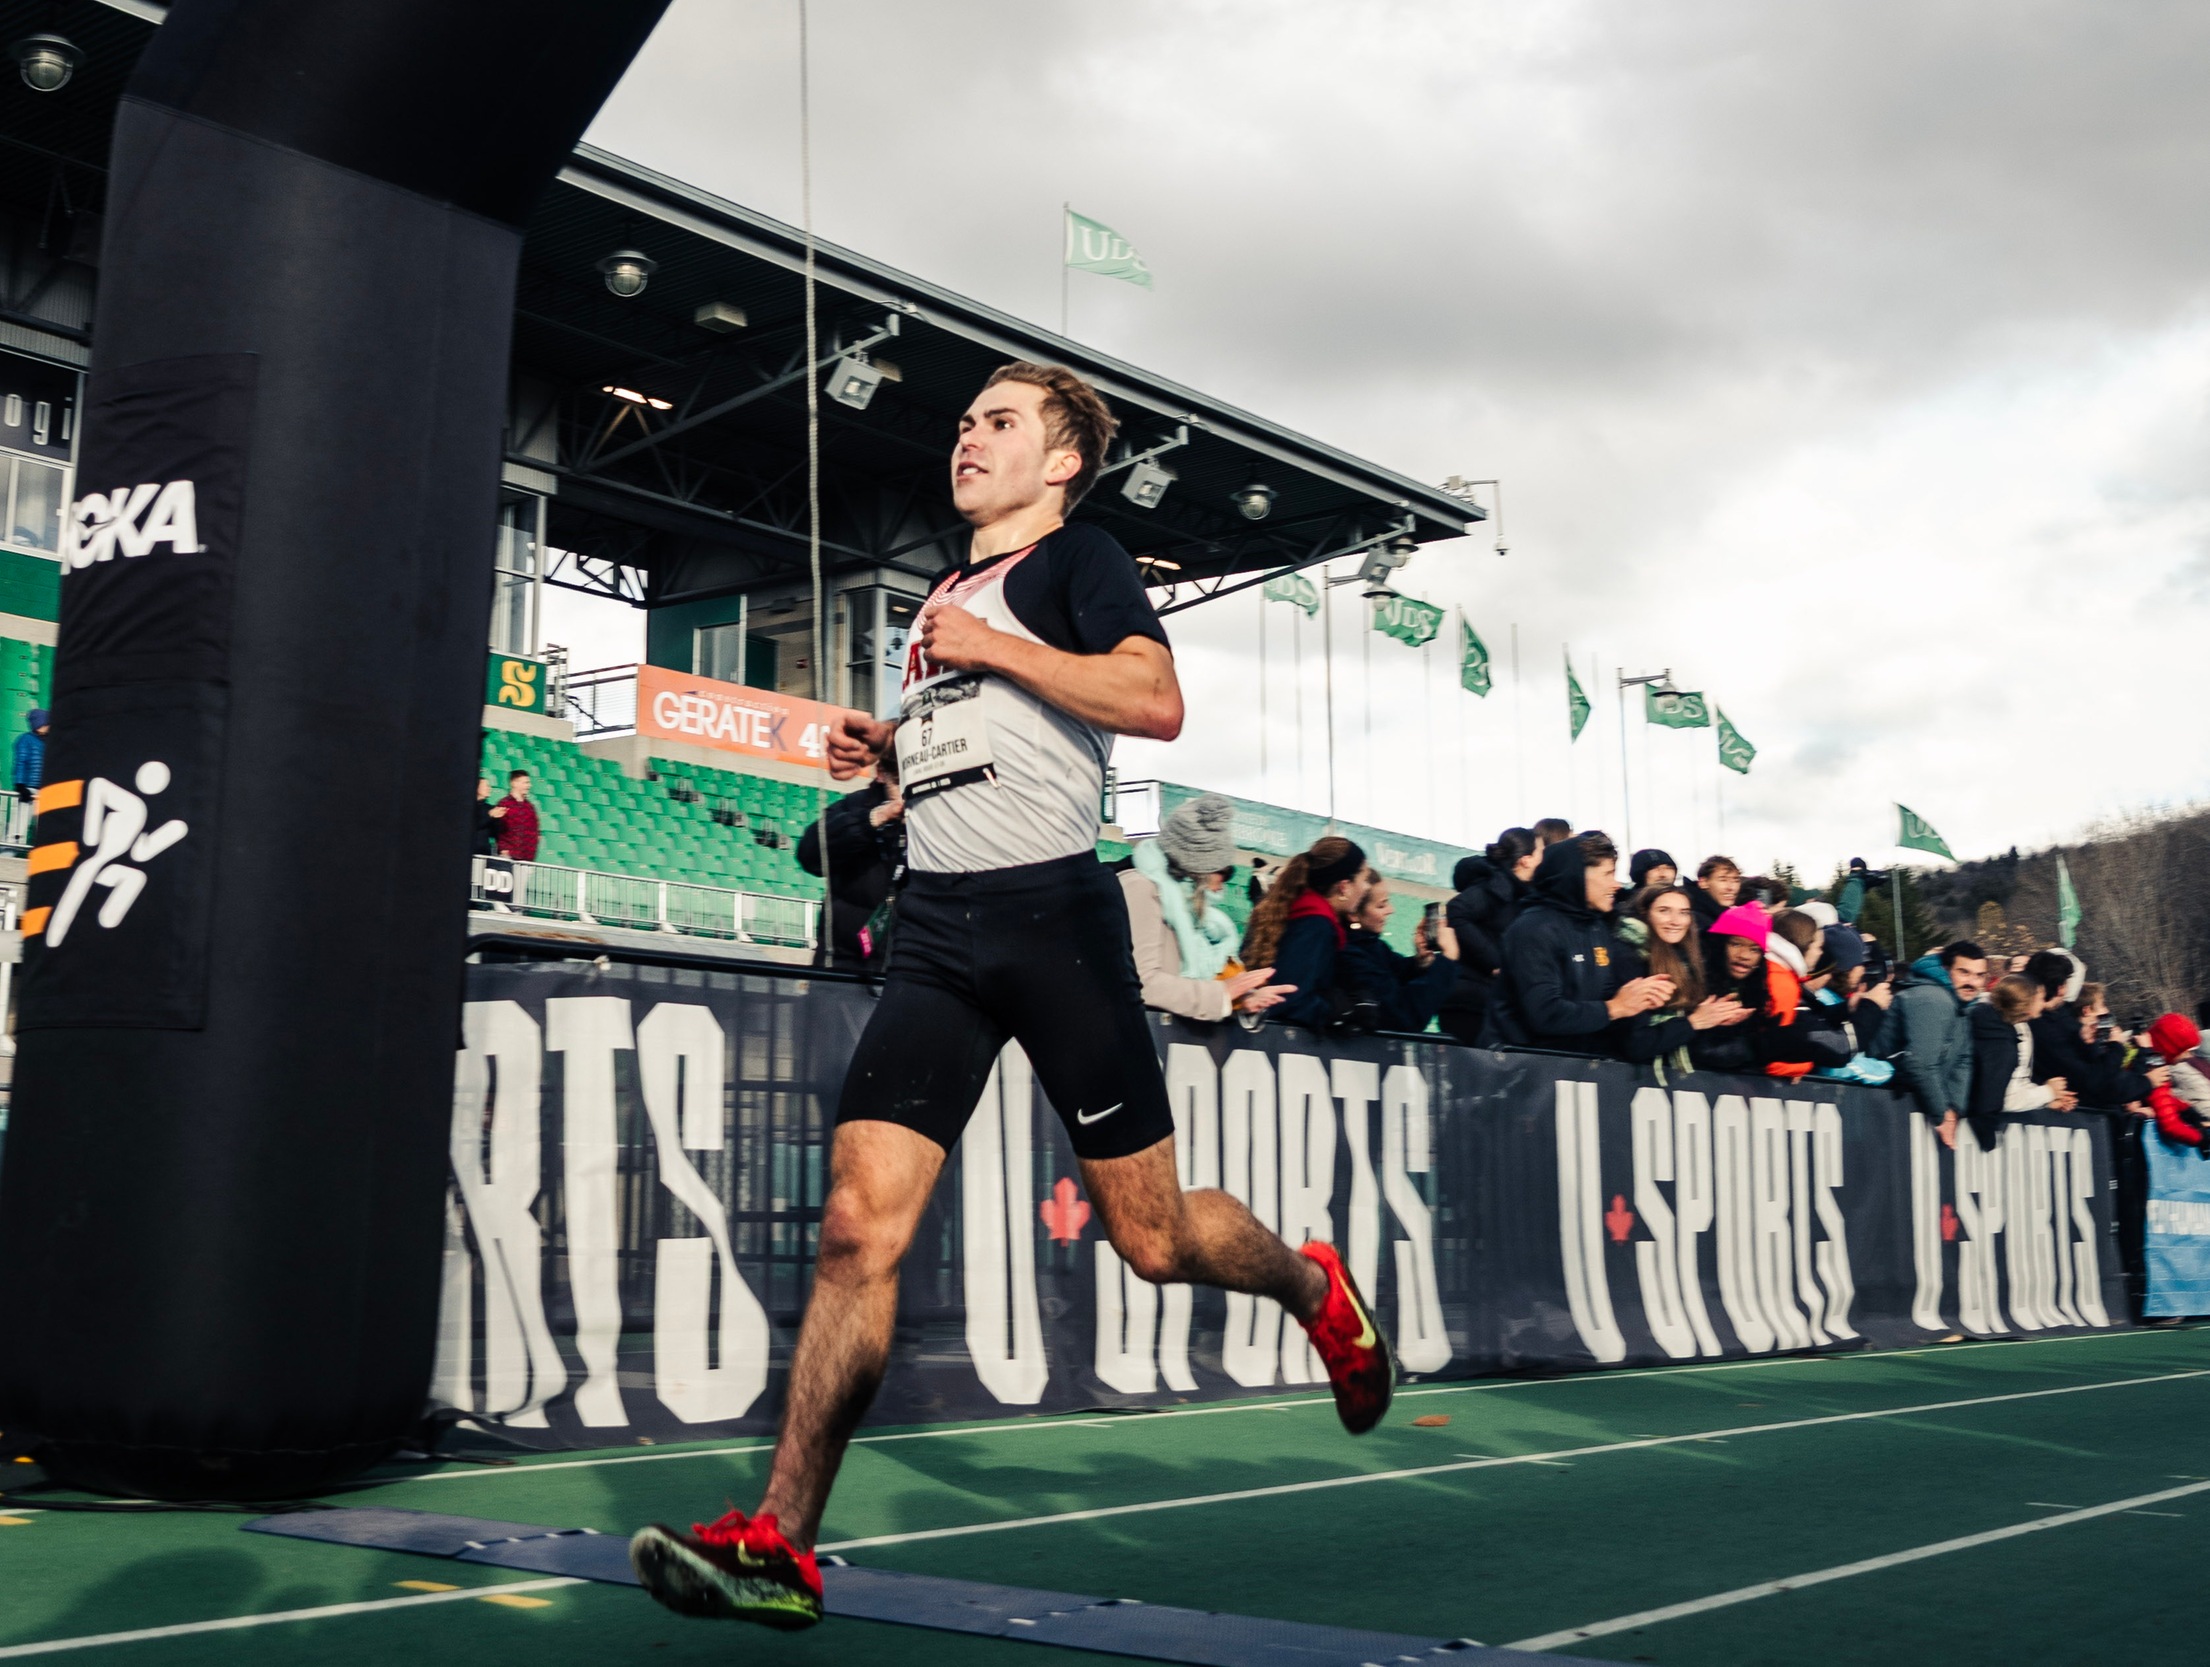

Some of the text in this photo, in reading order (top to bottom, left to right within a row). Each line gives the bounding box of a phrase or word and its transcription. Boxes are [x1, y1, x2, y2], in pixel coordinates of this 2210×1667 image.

[69, 480, 199, 569] OKA
[921, 727, 933, 747] 67
[430, 996, 770, 1428] RTS
[1555, 1080, 1860, 1363] U SPORTS
